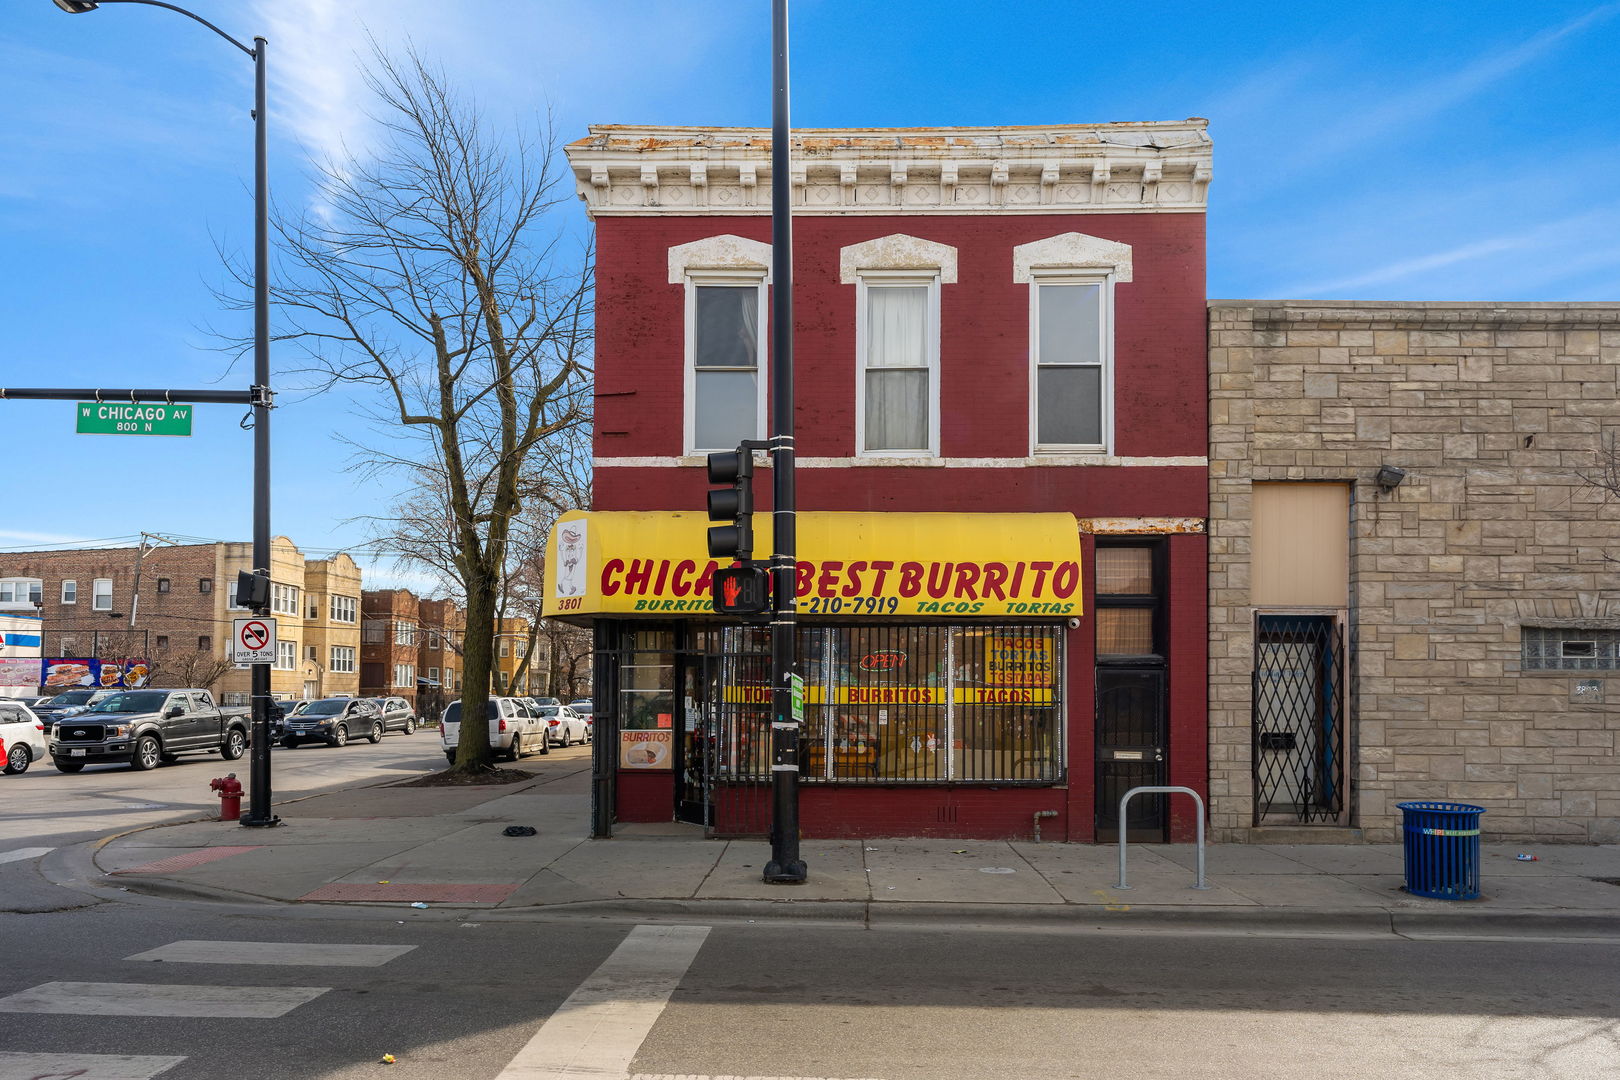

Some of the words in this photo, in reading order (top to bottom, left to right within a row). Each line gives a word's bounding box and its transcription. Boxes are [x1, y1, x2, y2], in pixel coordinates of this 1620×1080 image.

[82, 407, 91, 417] W
[98, 406, 166, 421] CHICAGO
[173, 410, 188, 420] AV
[116, 422, 138, 432] 800
[144, 423, 153, 432] N
[796, 560, 894, 598] BEST
[899, 560, 1080, 601] BURRITO
[558, 597, 582, 611] 3801
[916, 601, 985, 613] TACOS
[1006, 602, 1075, 614] TORTAS
[993, 638, 1043, 649] TACOS
[861, 654, 905, 669] OPEN
[991, 650, 1049, 661] TORTAS
[989, 661, 1051, 671] BURRITOS
[990, 672, 1050, 683] TOSTADAS
[849, 688, 932, 703] BURRITOS
[977, 689, 1031, 703] TACOS
[622, 732, 671, 743] BURRITOS
